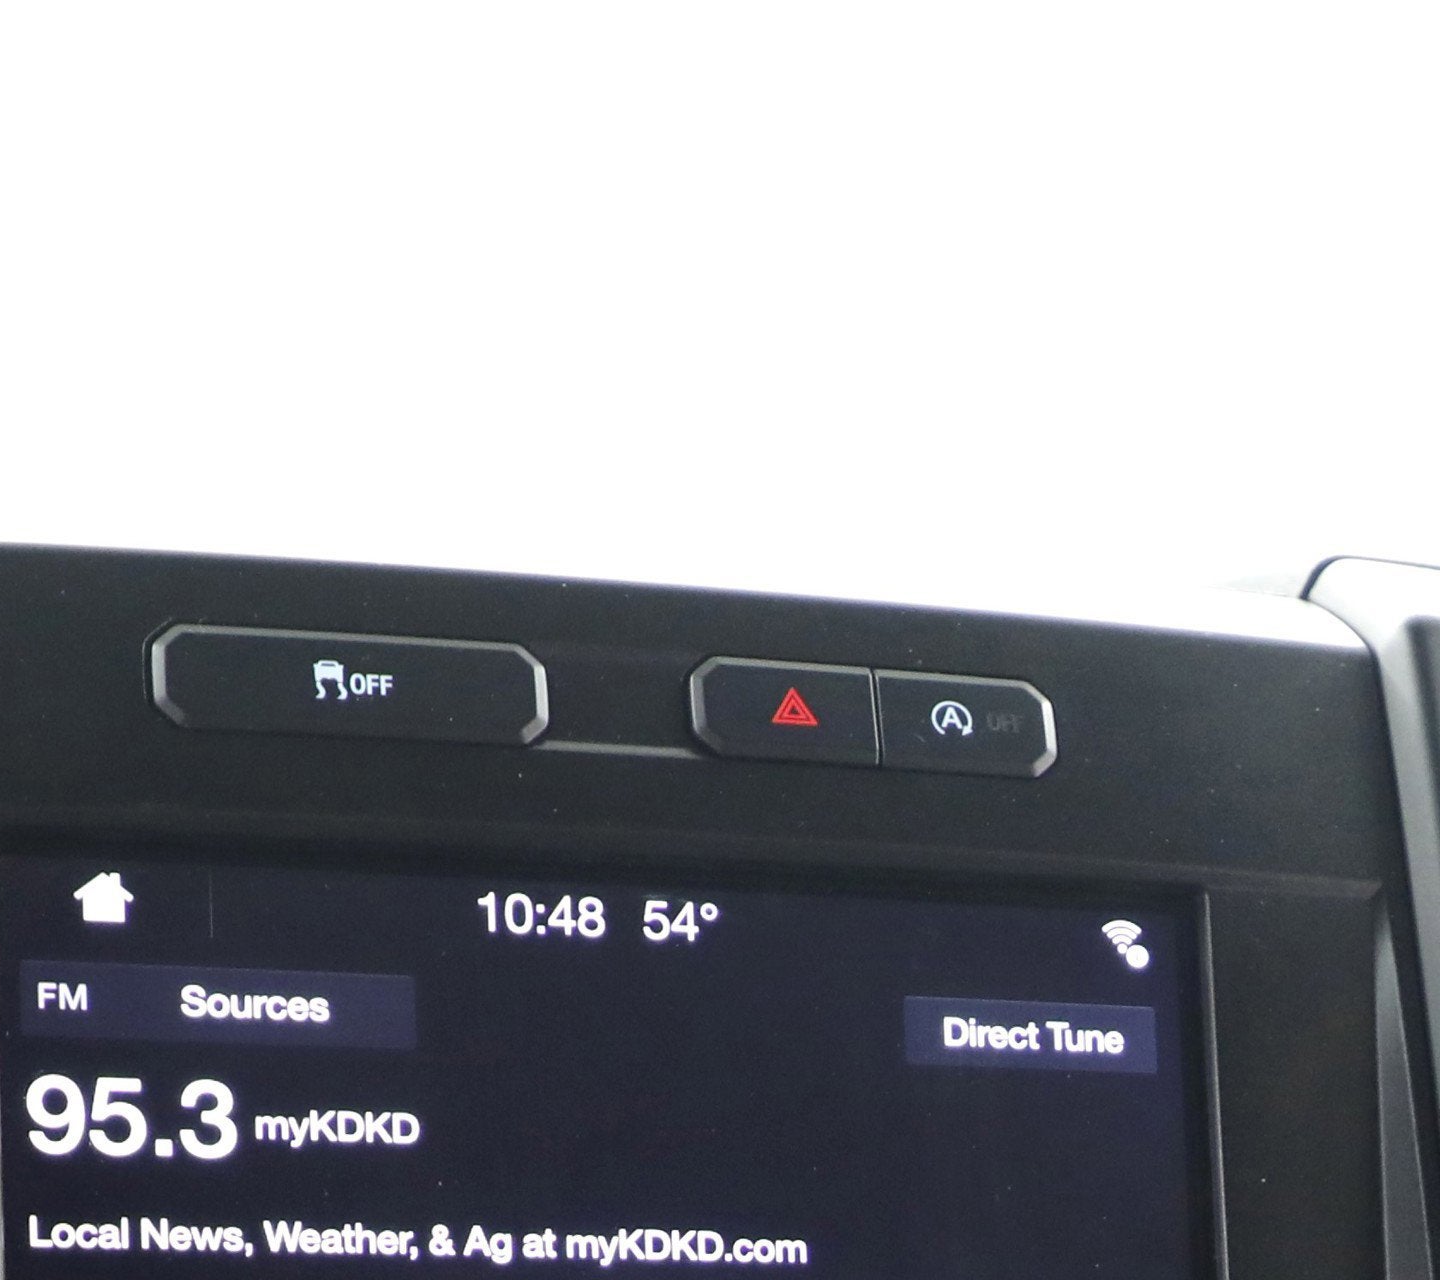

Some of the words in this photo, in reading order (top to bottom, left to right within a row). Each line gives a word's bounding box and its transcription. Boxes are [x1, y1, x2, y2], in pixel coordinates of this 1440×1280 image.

[349, 672, 394, 697] OFF
[477, 891, 607, 940] 10:48
[642, 899, 720, 943] 54°
[37, 981, 89, 1012] FM
[180, 984, 331, 1024] Sources
[943, 1016, 1041, 1051] Direct
[1045, 1020, 1126, 1056] Tune
[25, 1073, 239, 1161] 95.3
[254, 1109, 421, 1149] myKDKD
[28, 1214, 131, 1251] Local
[140, 1217, 255, 1258] News,
[262, 1219, 420, 1261] Weather,
[428, 1223, 457, 1258] &
[462, 1224, 515, 1266] Ag
[521, 1228, 558, 1260] at
[565, 1228, 809, 1269] myKDKD.com
